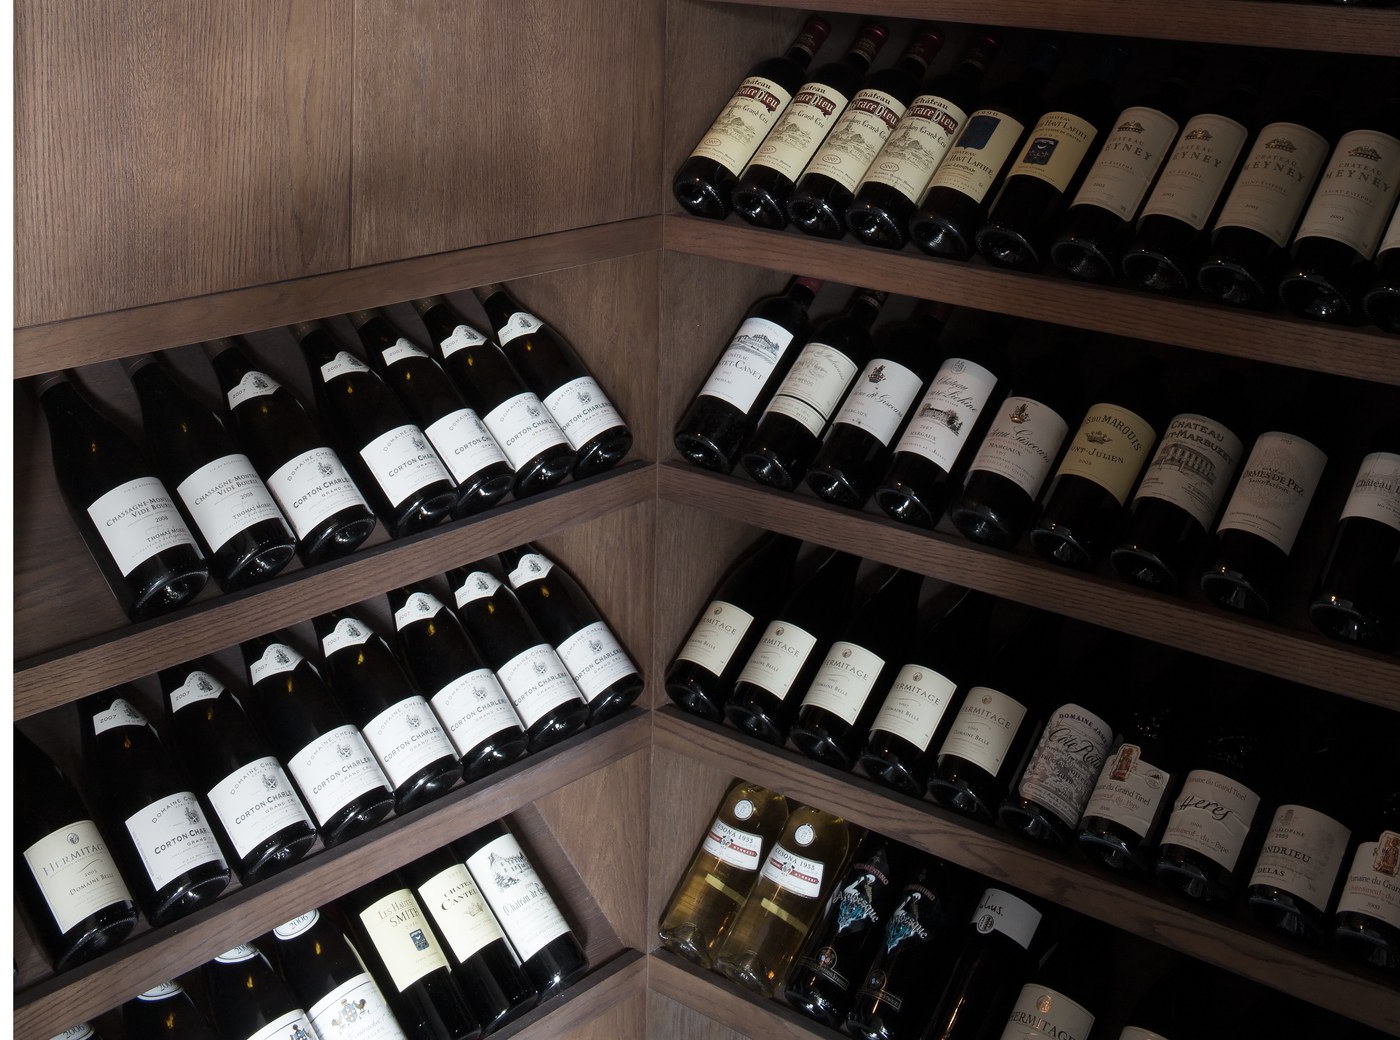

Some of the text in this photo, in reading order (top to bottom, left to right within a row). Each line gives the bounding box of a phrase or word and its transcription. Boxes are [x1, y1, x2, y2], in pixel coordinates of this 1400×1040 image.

[232, 388, 246, 399] 2007
[217, 485, 236, 496] VIDE
[131, 507, 150, 518] VIDE
[254, 663, 269, 674] 2007
[175, 691, 191, 701] 2007
[100, 714, 117, 724] 2007
[152, 798, 181, 824] DOMAINE
[1257, 867, 1285, 877] DELAS
[289, 914, 309, 930] 2006
[390, 908, 420, 928] SMITH
